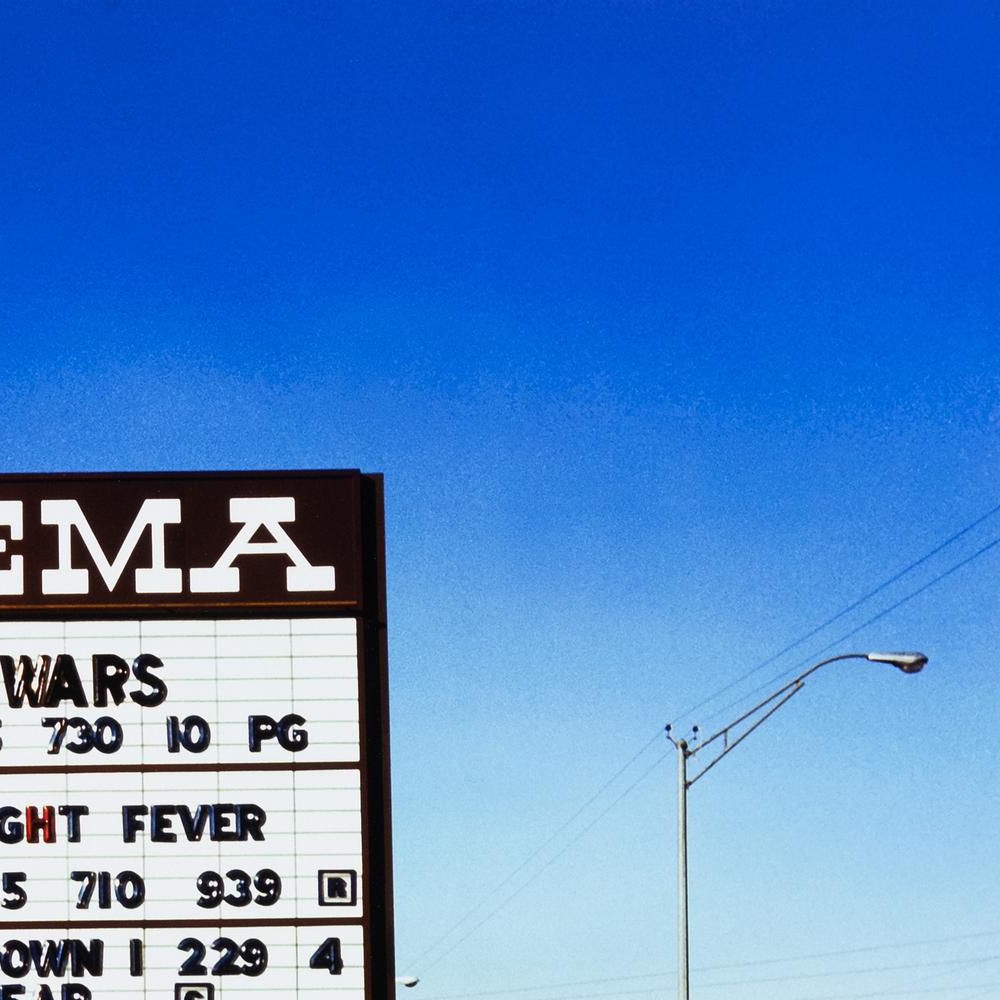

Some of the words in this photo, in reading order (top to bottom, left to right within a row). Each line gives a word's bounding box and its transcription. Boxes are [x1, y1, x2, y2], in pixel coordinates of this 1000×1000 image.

[0, 654, 167, 708] WARS
[42, 717, 123, 754] 730
[167, 716, 210, 753] 10
[249, 714, 308, 752] PG
[122, 804, 266, 843] FEVER
[2, 872, 27, 909] 5
[71, 871, 145, 909] 710
[197, 869, 281, 908] 939
[327, 877, 347, 898] R
[178, 937, 268, 976] 229
[310, 938, 343, 975] 4
